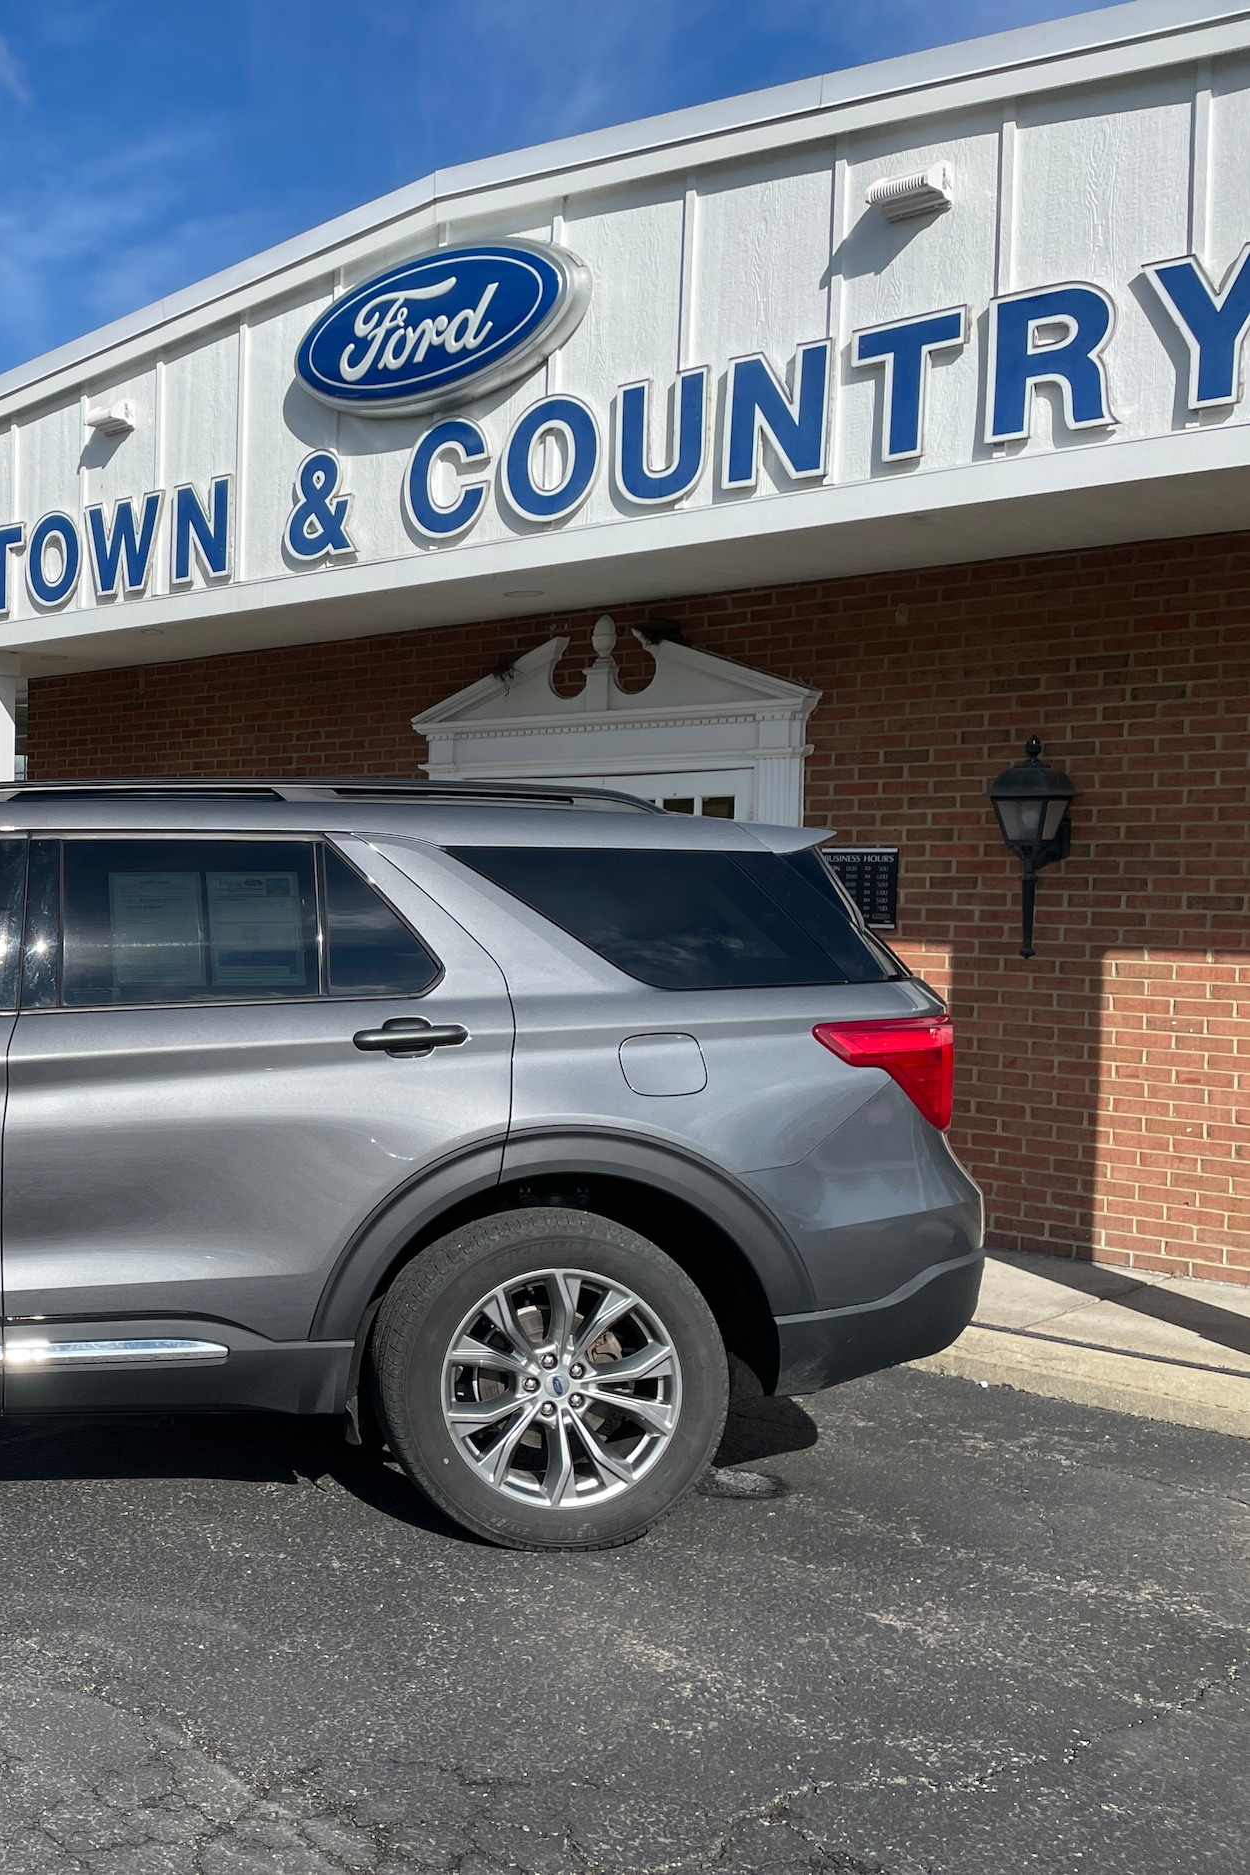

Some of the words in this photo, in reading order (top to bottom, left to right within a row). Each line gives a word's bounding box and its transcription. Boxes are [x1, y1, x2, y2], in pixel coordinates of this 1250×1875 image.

[339, 276, 499, 382] Ford
[284, 449, 357, 562] &
[405, 242, 1250, 539] COUNTRY
[825, 854, 861, 863] BUSINESS
[863, 854, 895, 863] HOURS
